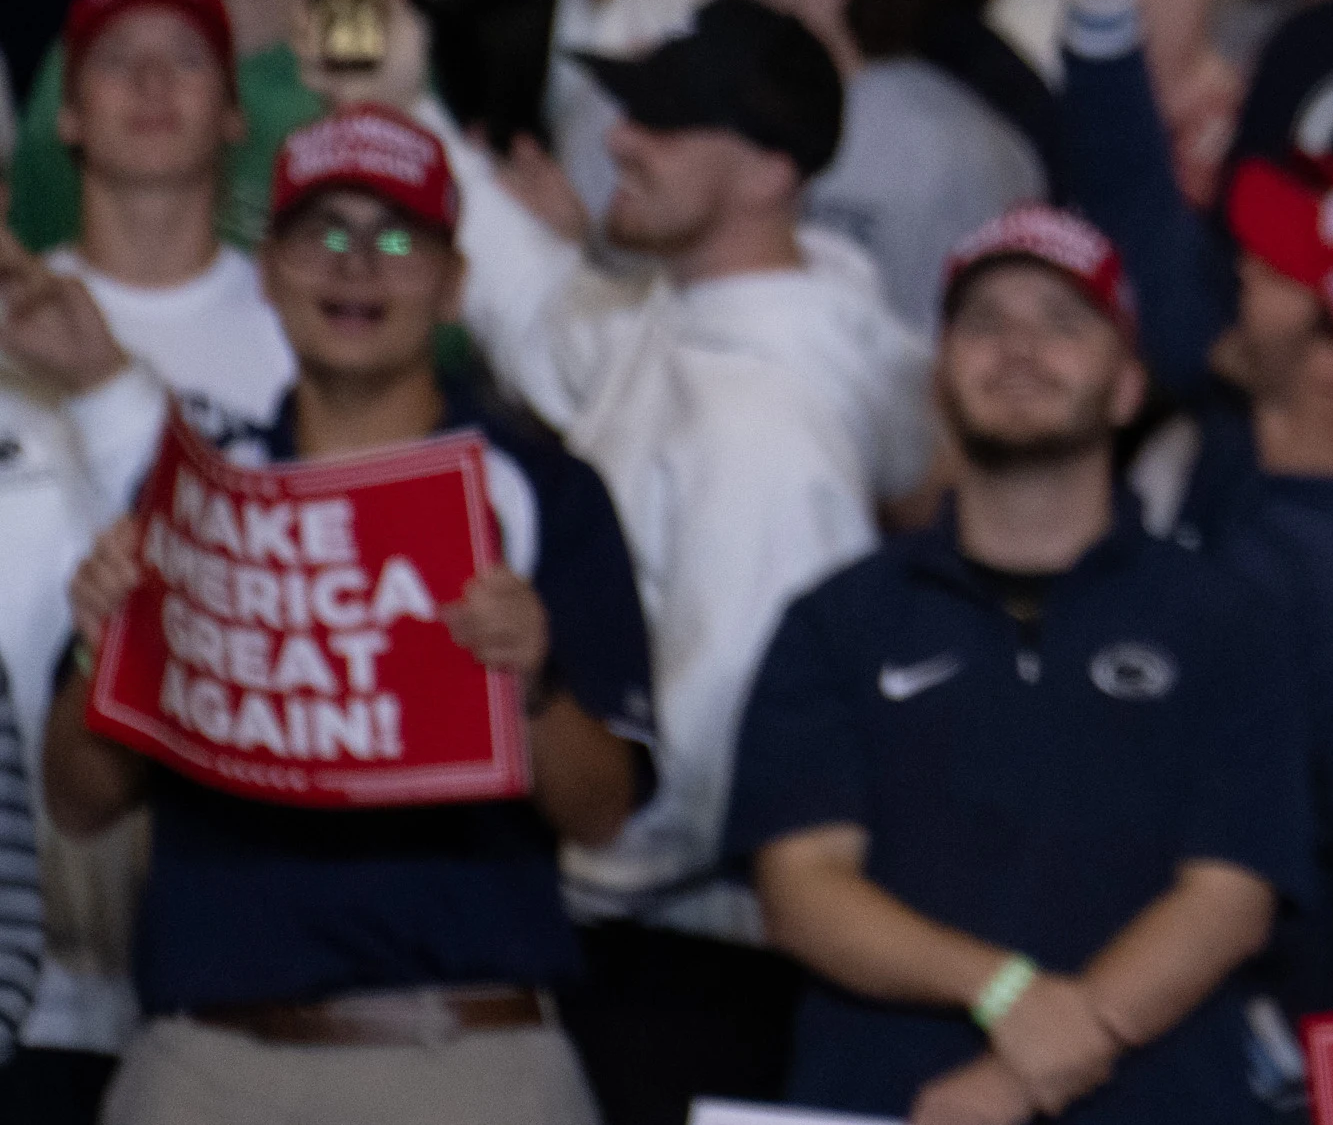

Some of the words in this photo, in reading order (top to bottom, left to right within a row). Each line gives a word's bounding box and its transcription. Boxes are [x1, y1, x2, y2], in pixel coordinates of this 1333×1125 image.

[143, 515, 437, 629] AMERICA
[172, 472, 357, 565] MAKE
[162, 587, 391, 697] GREAT
[158, 658, 403, 762] AGAIN!
